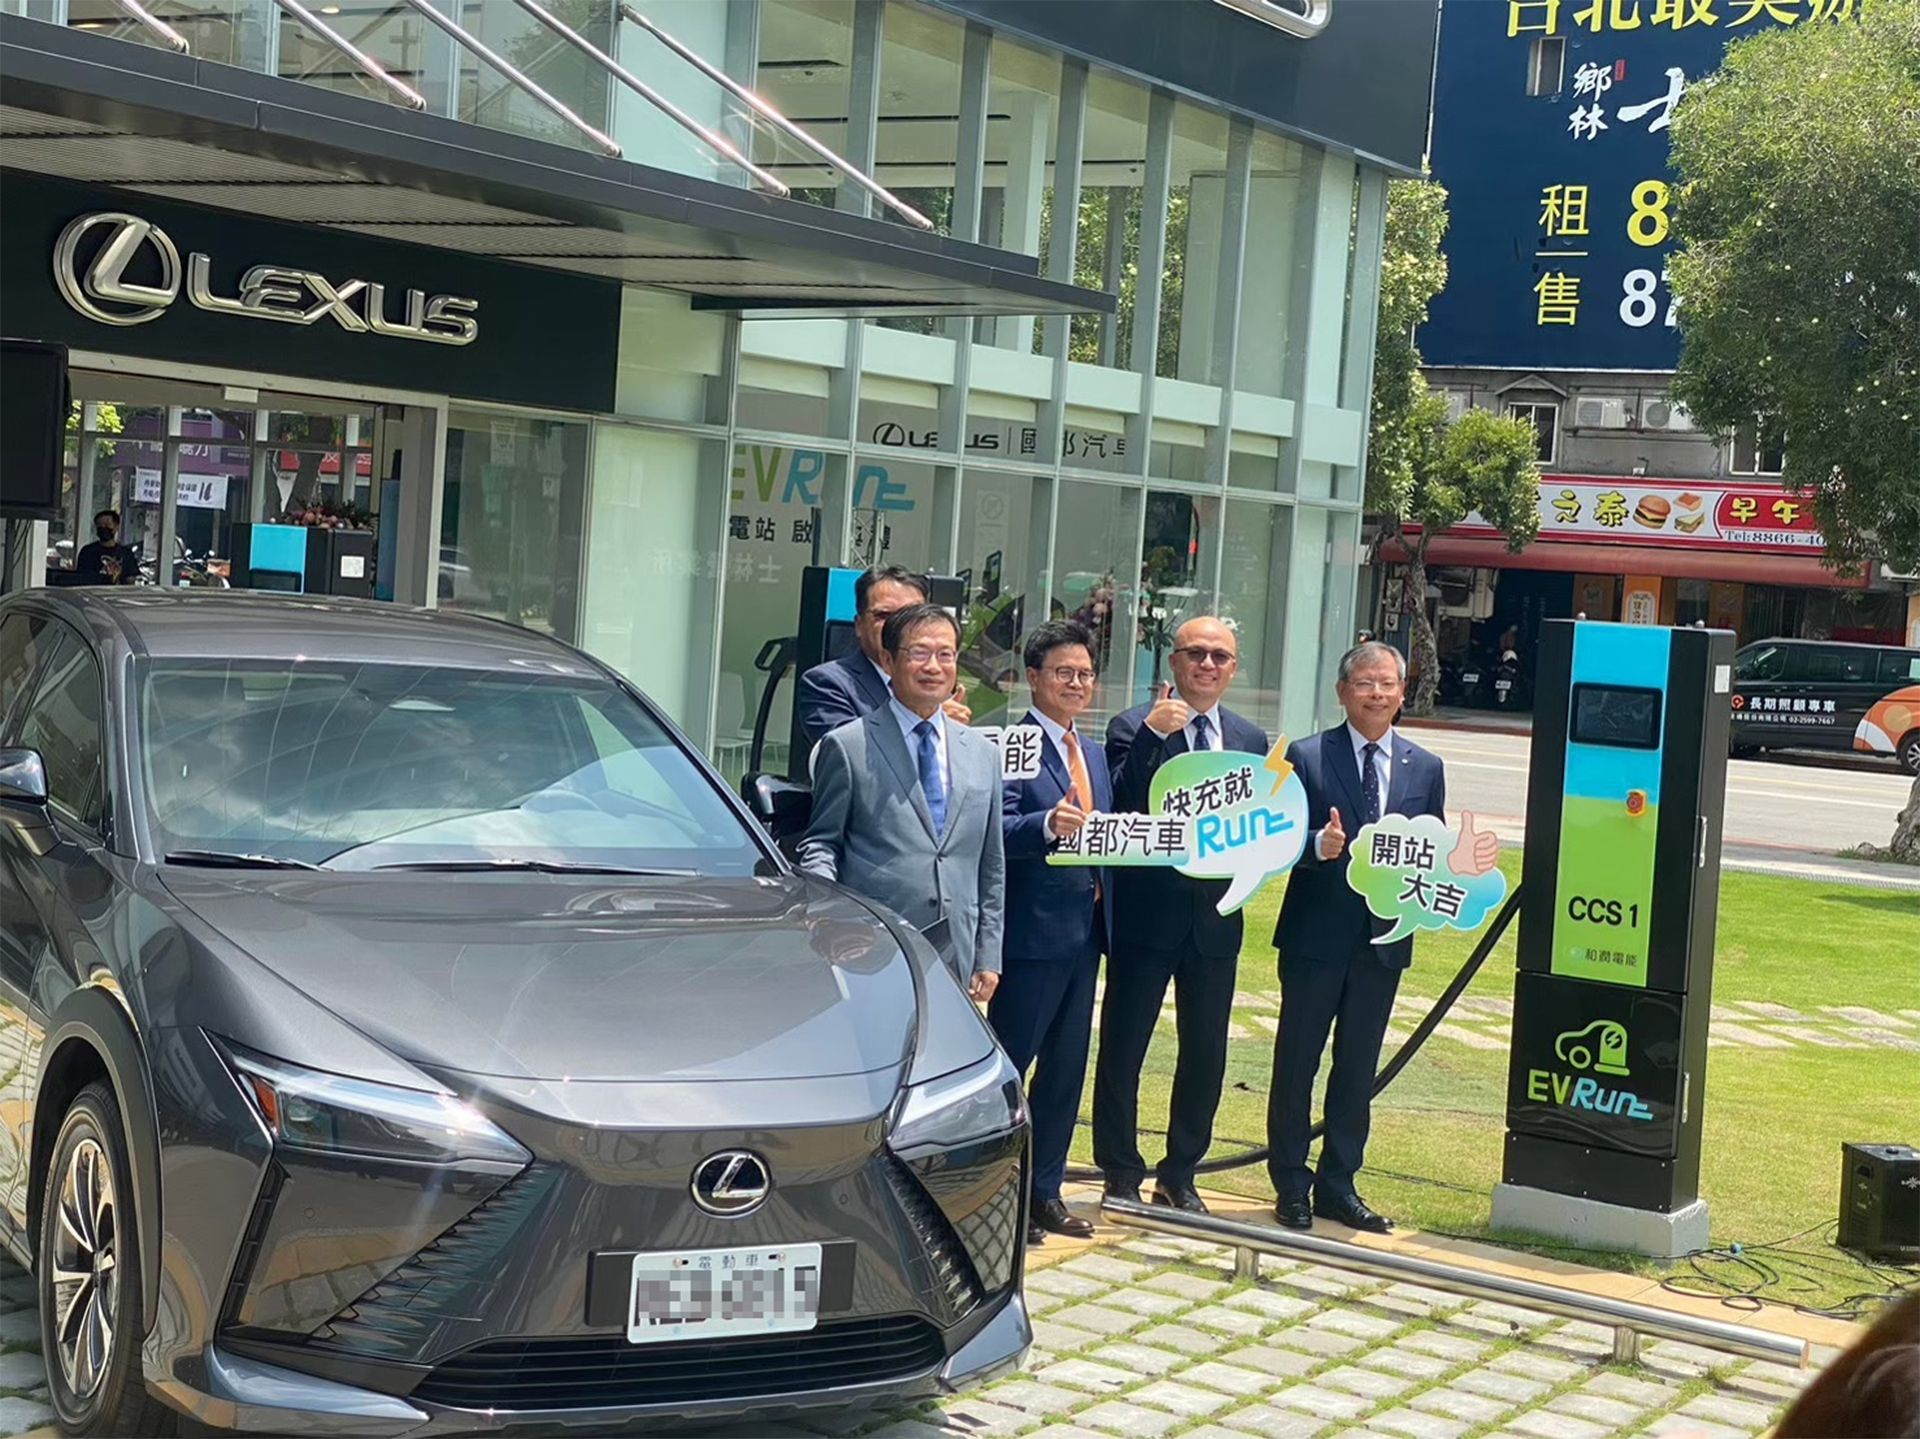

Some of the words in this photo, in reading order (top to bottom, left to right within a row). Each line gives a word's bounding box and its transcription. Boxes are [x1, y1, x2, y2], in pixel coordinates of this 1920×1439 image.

[1538, 184, 1590, 237] 租
[1626, 179, 1669, 247] 8
[186, 251, 479, 346] LEXUS
[1533, 272, 1581, 326] 售
[1533, 488, 1629, 528] 之泰
[1729, 497, 1800, 525] 早午
[1750, 696, 1836, 713] 長期照顧專車
[1162, 767, 1254, 818] 快充就
[1050, 818, 1186, 857] 國都汽車
[1371, 833, 1436, 870] 開站
[1399, 874, 1466, 918] 大吉
[1568, 895, 1623, 926] CCS
[1629, 903, 1638, 928] 1
